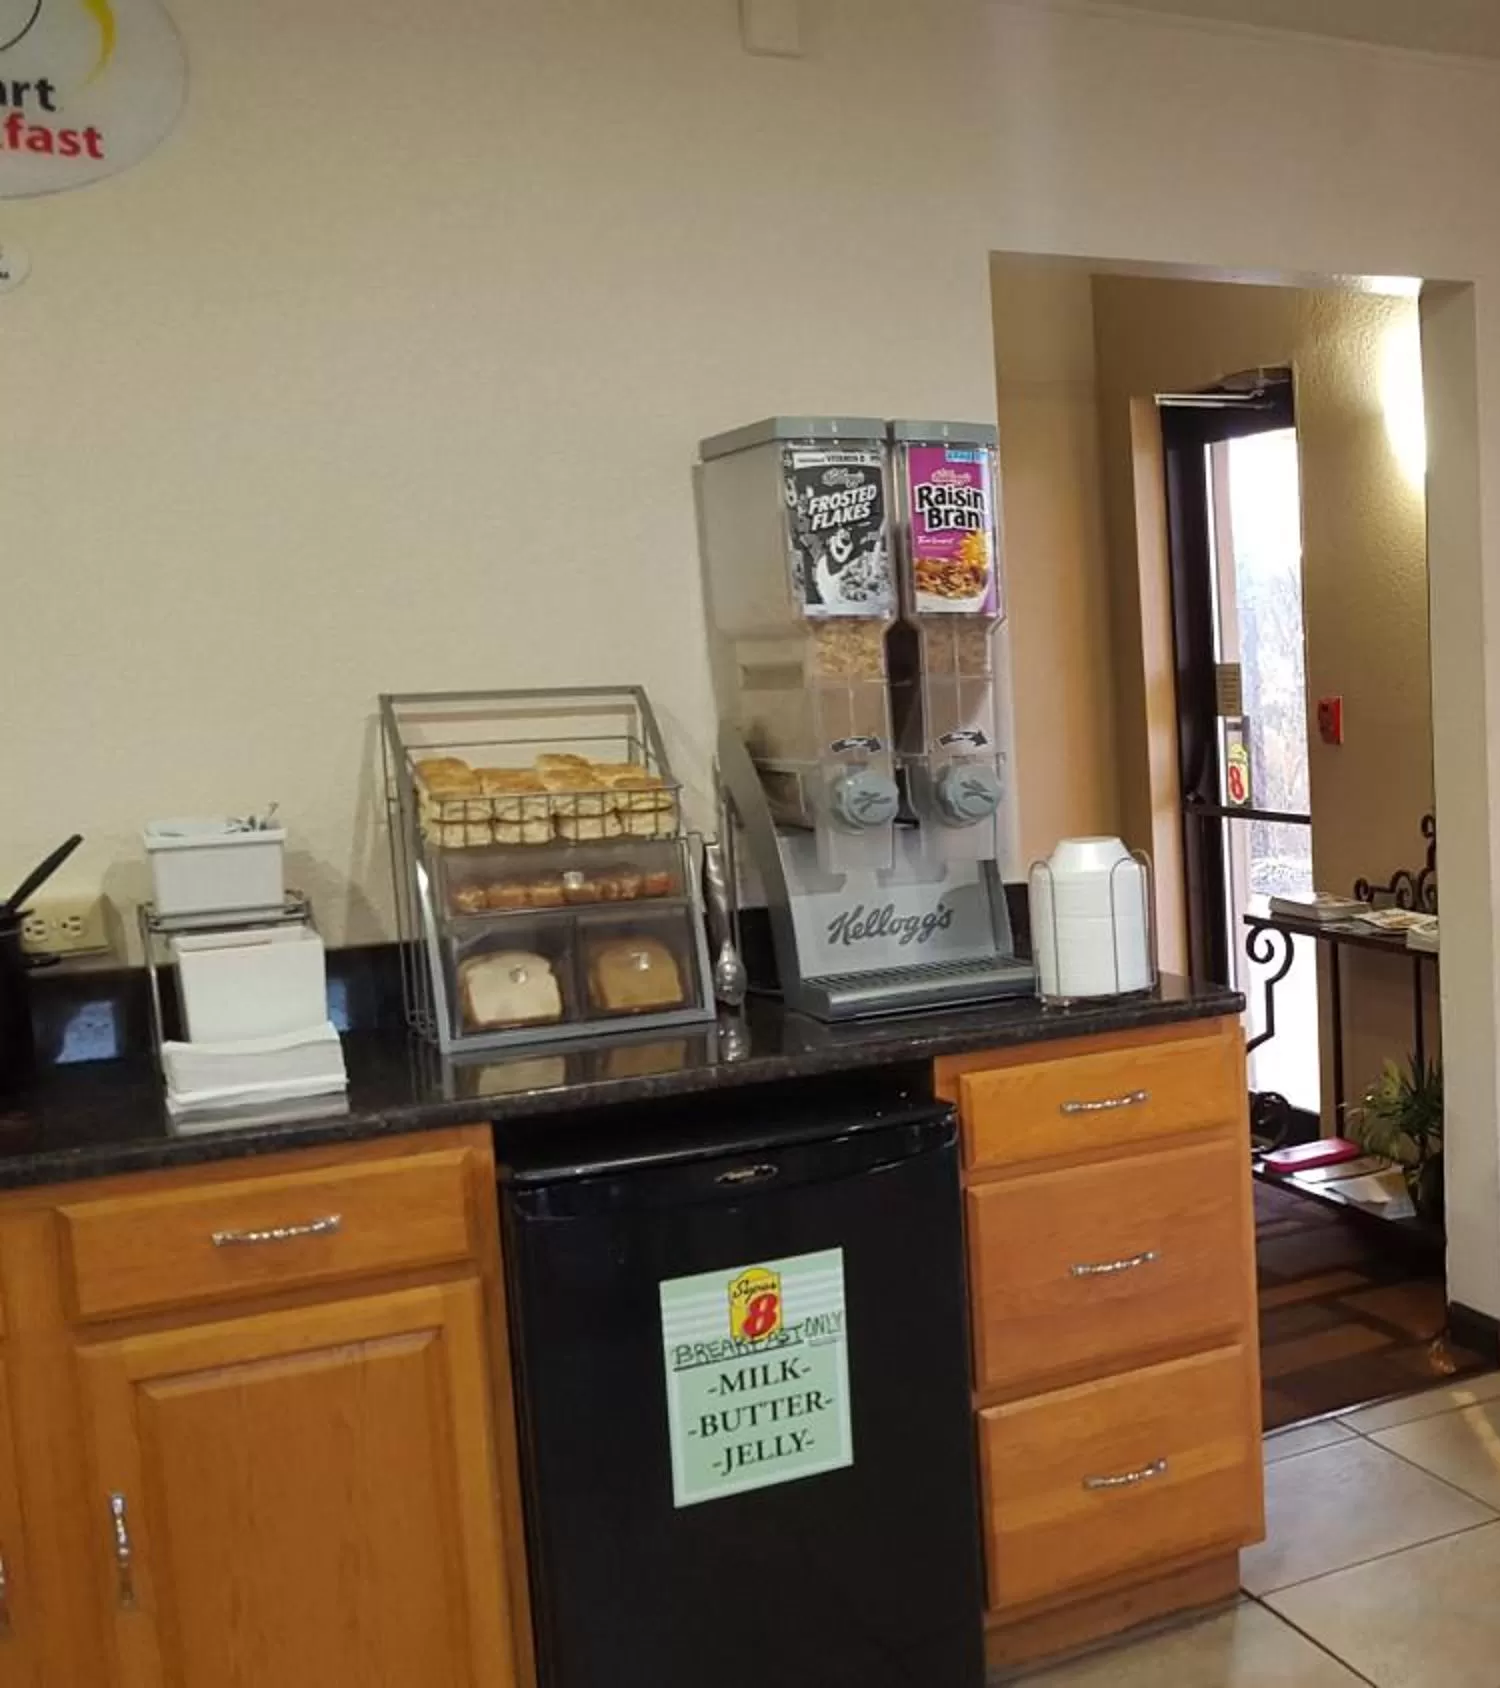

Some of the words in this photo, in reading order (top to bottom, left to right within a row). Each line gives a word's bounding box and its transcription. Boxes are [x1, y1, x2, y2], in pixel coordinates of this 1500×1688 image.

[808, 484, 877, 516] FROSTED
[917, 484, 986, 512] Raisin
[811, 501, 871, 531] FLAKES
[926, 507, 981, 529] Bran
[827, 902, 955, 946] Kellogg's
[743, 1293, 778, 1338] 8
[675, 1324, 803, 1366] BREAKFAST
[805, 1311, 843, 1337] ONLY
